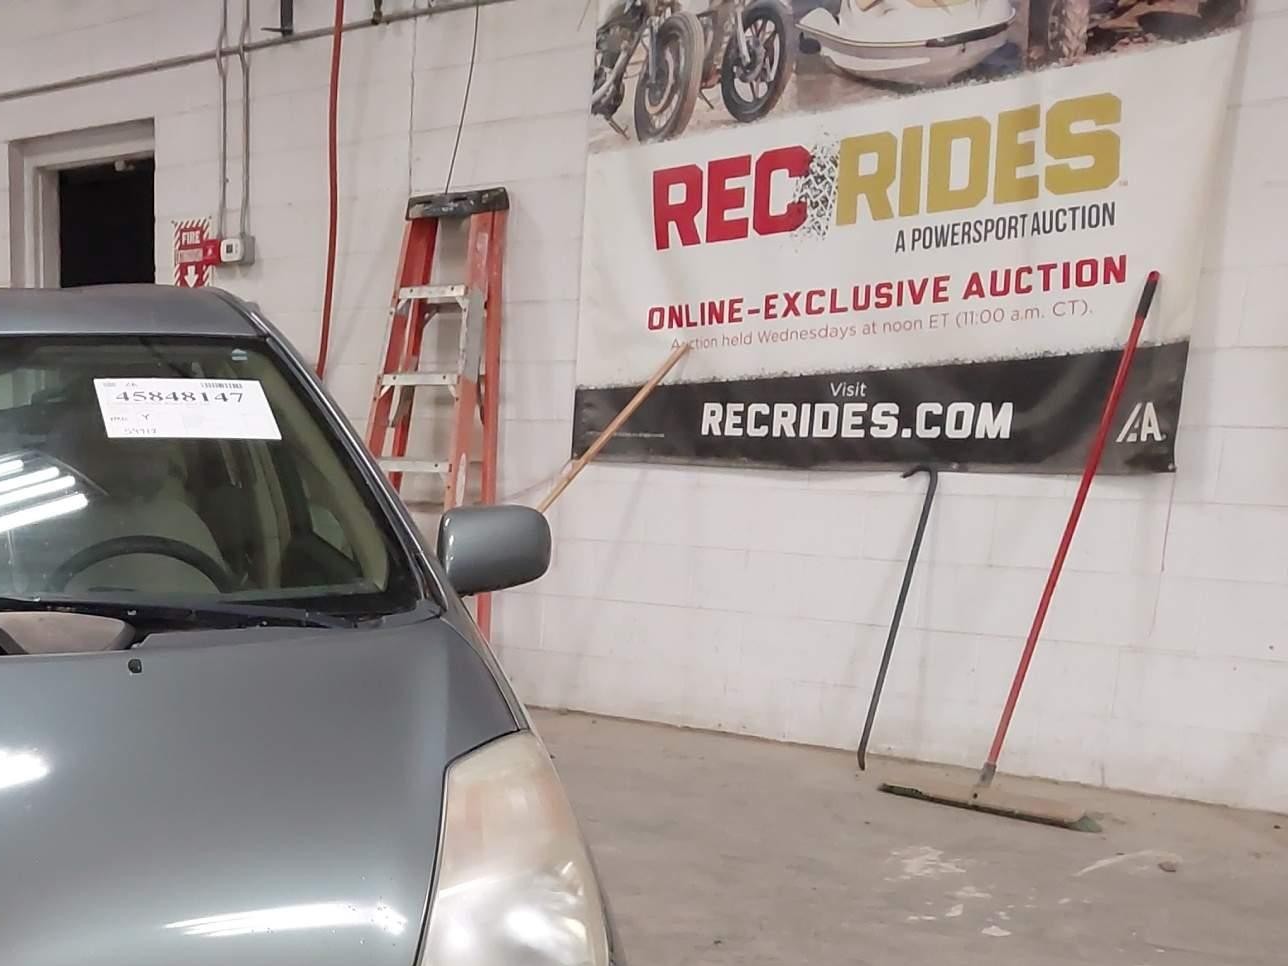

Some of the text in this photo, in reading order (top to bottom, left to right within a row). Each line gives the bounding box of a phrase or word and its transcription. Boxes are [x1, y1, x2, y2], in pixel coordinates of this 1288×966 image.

[652, 92, 1122, 251] REC RIDES
[181, 230, 201, 245] FIRE
[894, 201, 1116, 253] A POWERSPORT AUCTION
[647, 254, 1127, 331] ONLINE-EXCLUSIVE AUCTION
[721, 331, 753, 347] held
[758, 323, 857, 343] Wednesdays
[862, 320, 878, 336] at
[882, 317, 923, 334] noon
[929, 312, 949, 329] ET
[955, 307, 1005, 328] (11:00
[1011, 306, 1045, 322] a.m.
[1052, 299, 1093, 317] CT).
[115, 391, 244, 403] 45848147
[830, 381, 868, 399] Visit
[700, 401, 1013, 439] RECRIDES.COM
